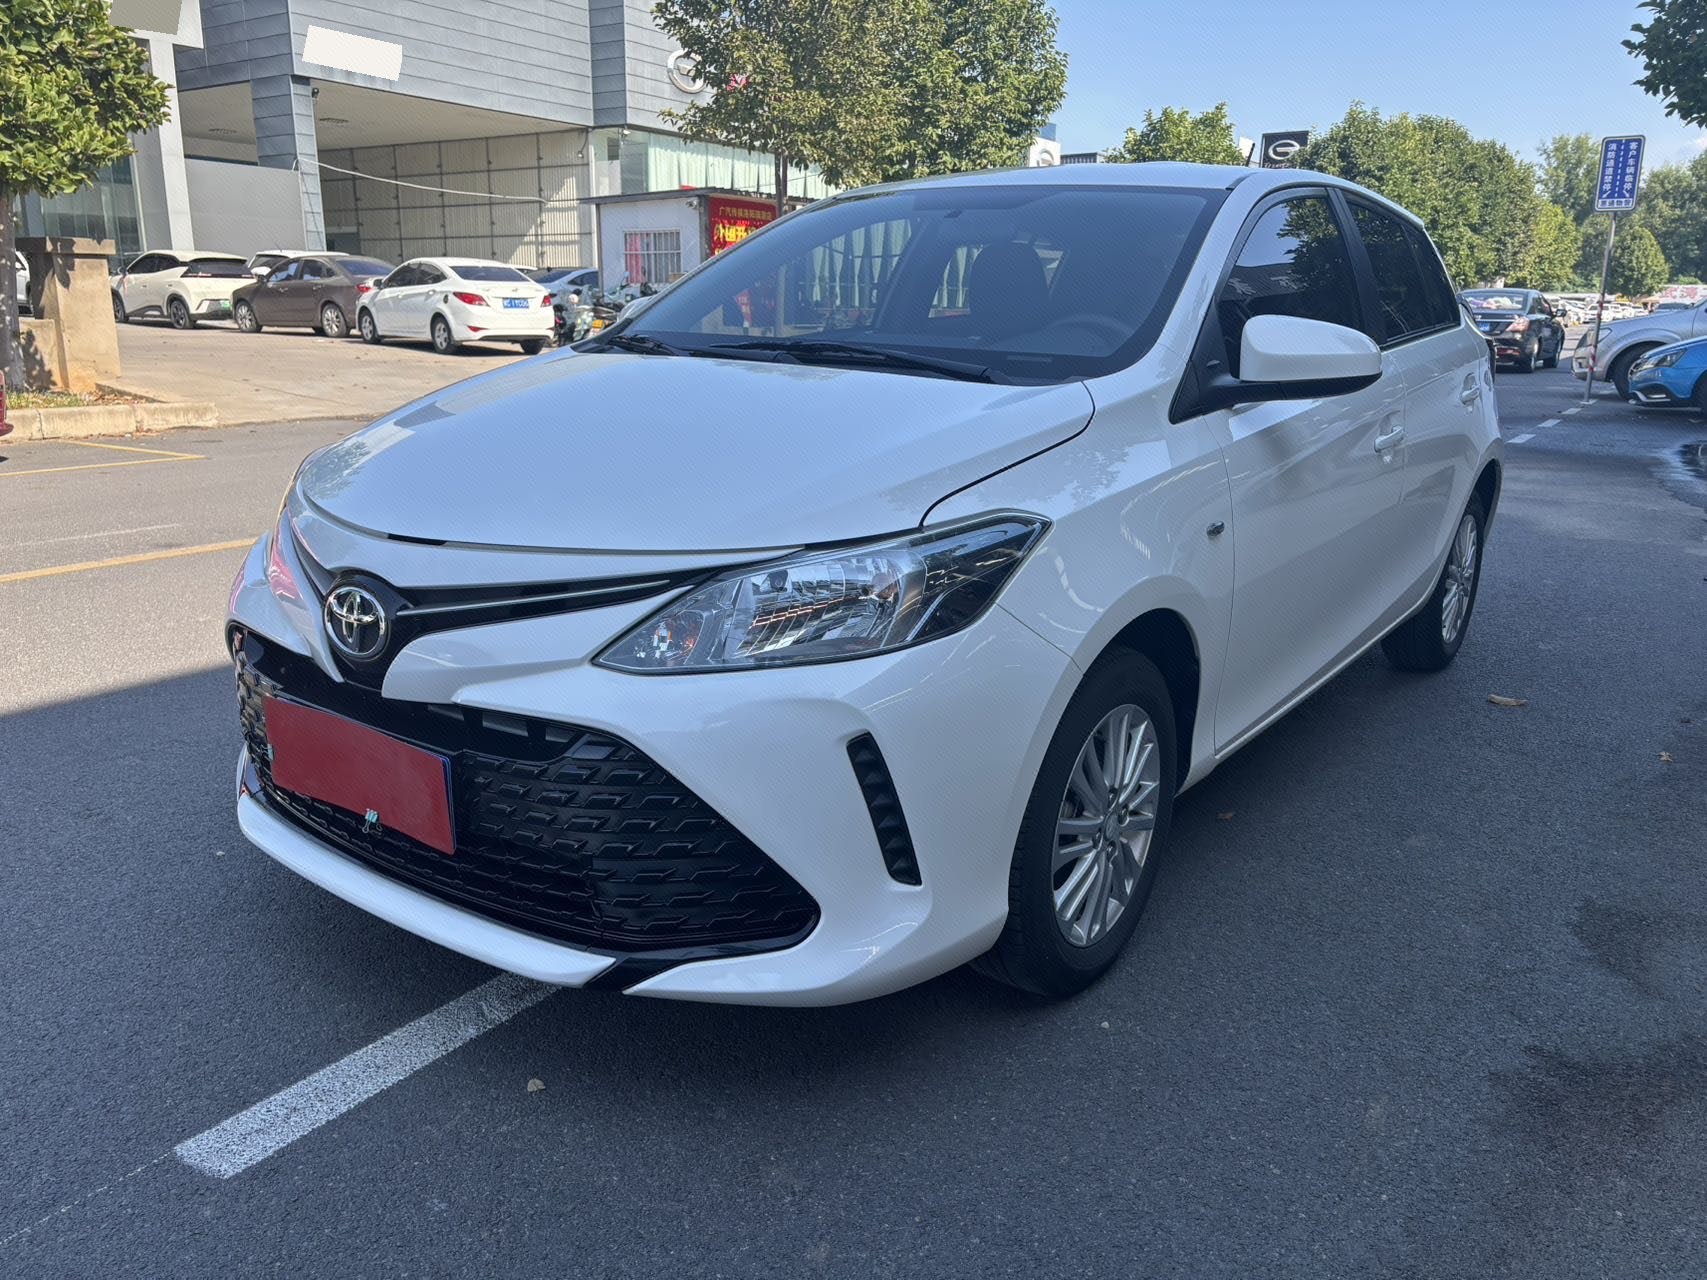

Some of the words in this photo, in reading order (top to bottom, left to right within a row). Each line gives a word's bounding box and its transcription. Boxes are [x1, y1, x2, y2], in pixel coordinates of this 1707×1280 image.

[1602, 143, 1617, 191] 消防通道禁停
